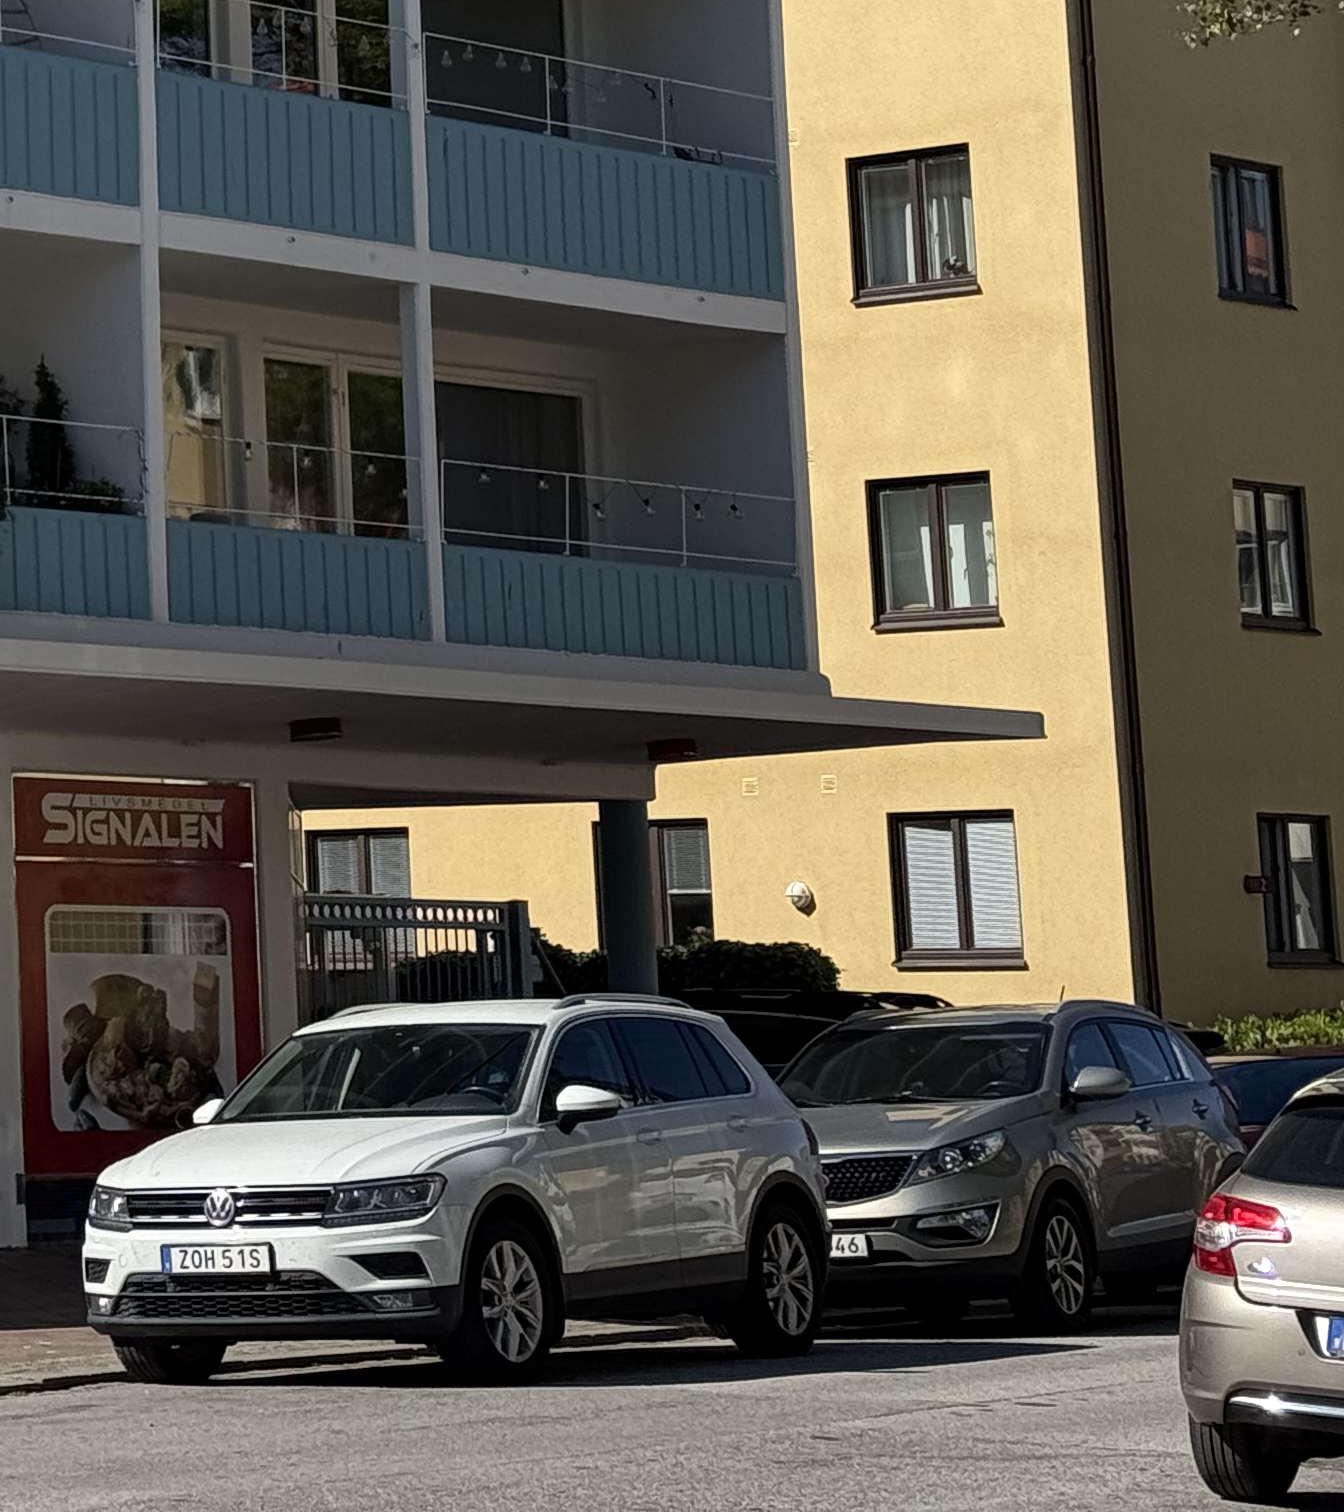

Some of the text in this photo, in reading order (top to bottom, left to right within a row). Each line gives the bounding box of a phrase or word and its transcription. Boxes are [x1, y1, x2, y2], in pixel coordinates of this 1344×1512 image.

[89, 795, 210, 811] LIVSMEDEL
[41, 792, 224, 849] SIGNALEN
[835, 1236, 860, 1255] 46
[178, 1248, 216, 1270] ZOH
